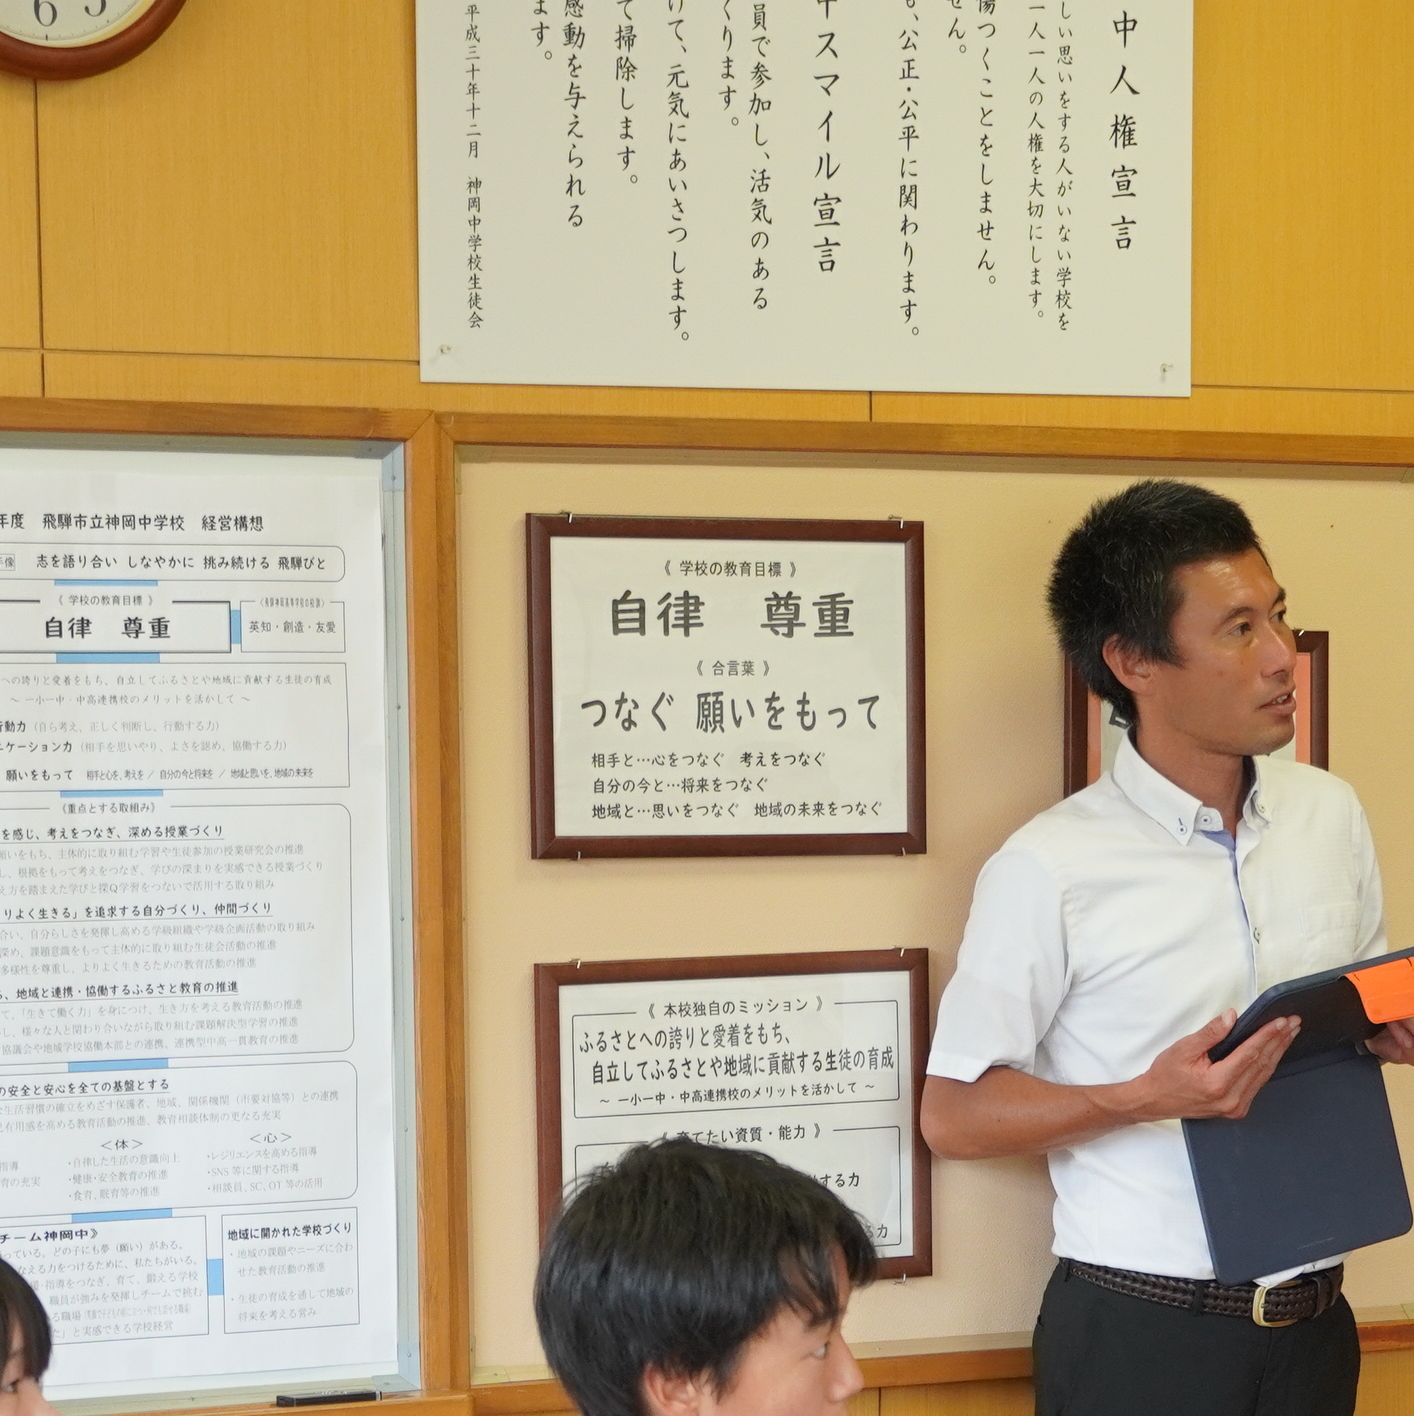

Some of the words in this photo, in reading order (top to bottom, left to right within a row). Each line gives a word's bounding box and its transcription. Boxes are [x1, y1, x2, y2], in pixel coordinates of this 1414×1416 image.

[464, 4, 482, 159] 平成三十年十二月
[563, 0, 586, 229] 感動を与えられる
[614, 0, 638, 185] て掃除します。
[1108, 9, 1142, 253] 中人権宣言
[748, 3, 773, 312] 員で参加し、活気のある
[897, 0, 920, 336] 、公正・公平に関わります。
[1026, 5, 1046, 321] 一人一人の人権を大切にします。
[1054, 1, 1075, 332] しい思いをする人がいない学校を
[466, 176, 484, 329] 神岡中学校生徒会
[36, 553, 118, 569] 志を語り合い
[127, 555, 195, 569] しなやかに
[203, 556, 270, 570] 挑み続ける
[201, 514, 264, 532] 経営構想
[45, 616, 93, 639] 自律
[121, 616, 171, 639] 尊重
[611, 589, 705, 637] 自律
[760, 590, 854, 638] 尊重
[581, 691, 674, 732] つなぐ
[696, 691, 880, 733] 願いをもって
[740, 751, 826, 768] 考えをつなぐ
[5, 769, 74, 782] 願いをもって
[754, 801, 883, 818] 地域の未来をつなぐ
[579, 1021, 792, 1053] ふるさとへの誇りと愛着をもち、
